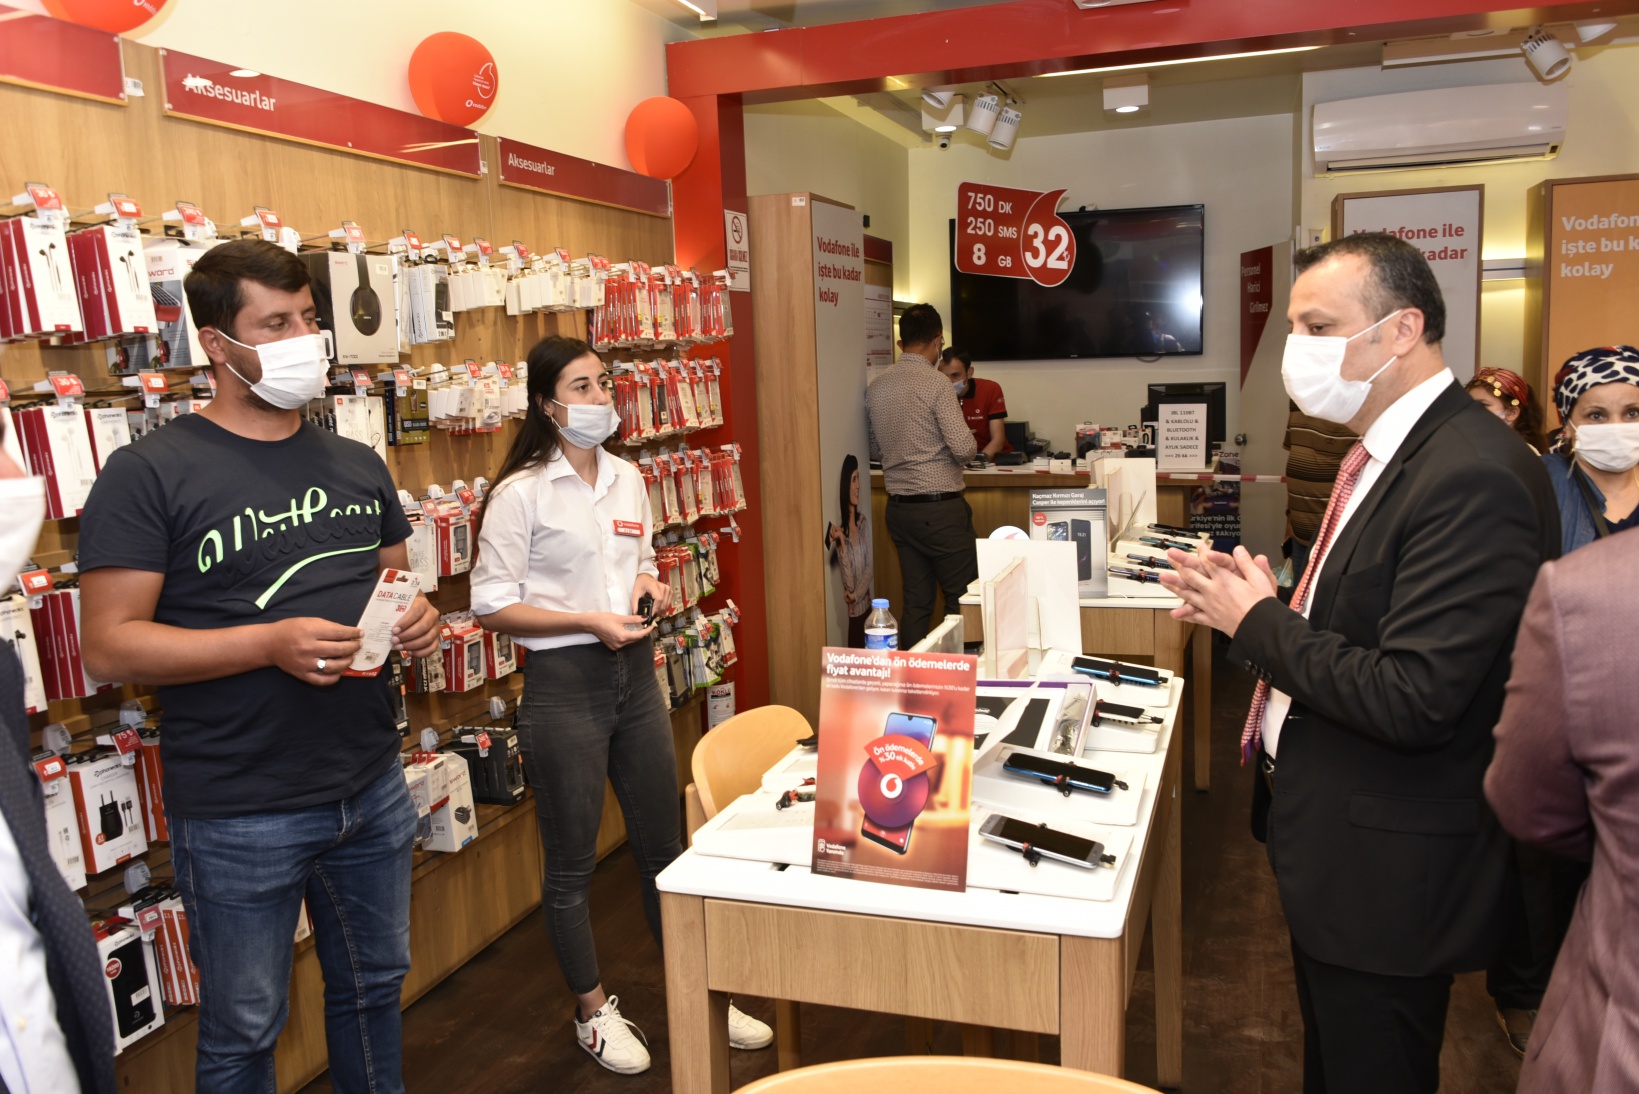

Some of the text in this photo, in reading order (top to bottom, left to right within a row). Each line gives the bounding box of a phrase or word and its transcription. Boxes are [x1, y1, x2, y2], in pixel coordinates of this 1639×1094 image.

[184, 73, 276, 111] Aksesuarlar
[508, 153, 555, 176] Aksesuarlar
[967, 192, 1012, 214] 750 DK
[966, 217, 1017, 239] 250 SMS
[1442, 224, 1465, 238] ile
[817, 236, 860, 258] Vodafone ile
[972, 243, 1012, 268] 8 GB
[1025, 223, 1069, 270] 32
[1561, 240, 1596, 258] işte
[1601, 238, 1624, 252] bu
[148, 268, 174, 277] word
[818, 262, 861, 282] işte bu kadar
[1560, 262, 1614, 280] kolay
[819, 287, 839, 308] kolay
[58, 378, 69, 386] 30
[377, 590, 394, 599] DATA
[393, 592, 412, 602] CABLE
[826, 652, 970, 672] Vodafone'dan ön ödemelerde
[826, 665, 891, 680] fiyat avantajı!
[116, 732, 127, 740] 75
[873, 743, 924, 765] Ön ödemelerde
[879, 752, 896, 763] %30
[409, 781, 424, 792] word
